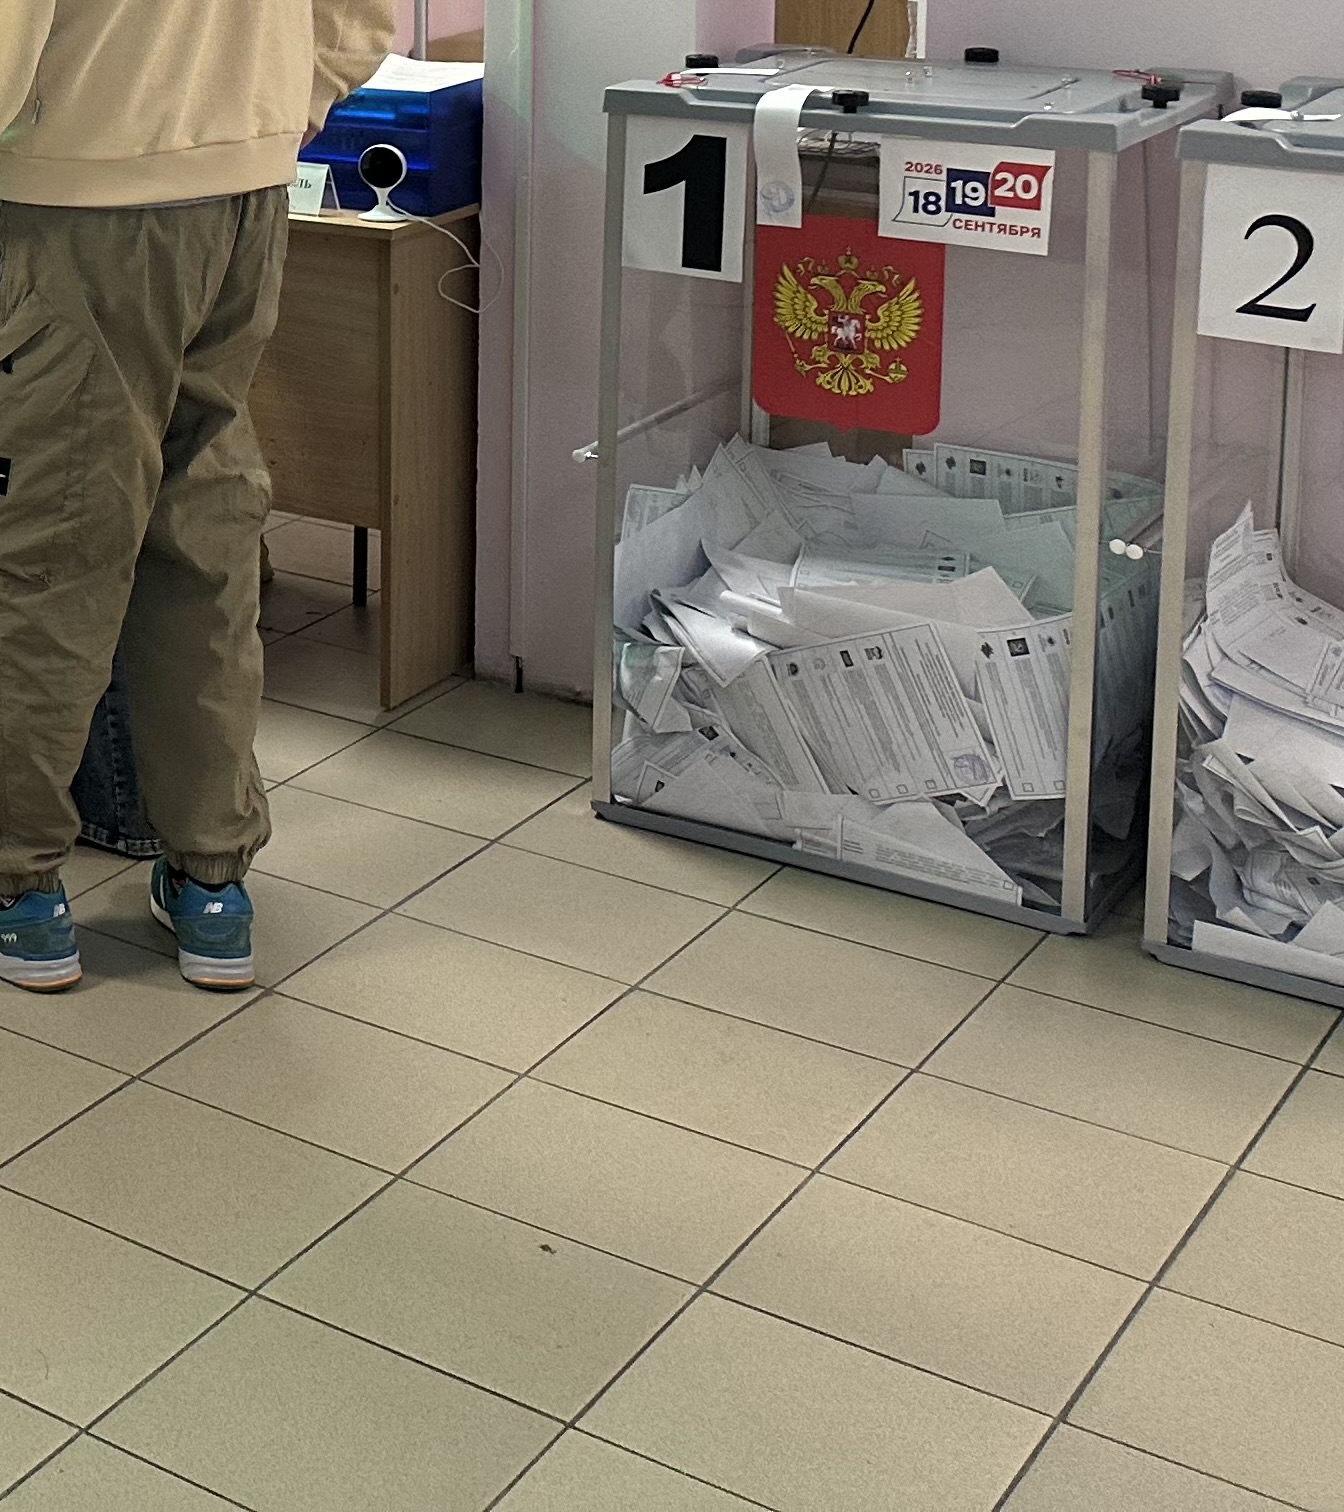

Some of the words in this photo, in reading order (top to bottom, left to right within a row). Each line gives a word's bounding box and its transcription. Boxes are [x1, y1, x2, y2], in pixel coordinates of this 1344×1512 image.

[904, 161, 943, 175] 2026
[950, 179, 986, 207] 19
[994, 171, 1039, 200] 20
[643, 133, 728, 273] 1
[908, 189, 942, 216] 18
[952, 218, 1042, 238] СЕНТЯБРЯ
[1235, 214, 1317, 322] 2
